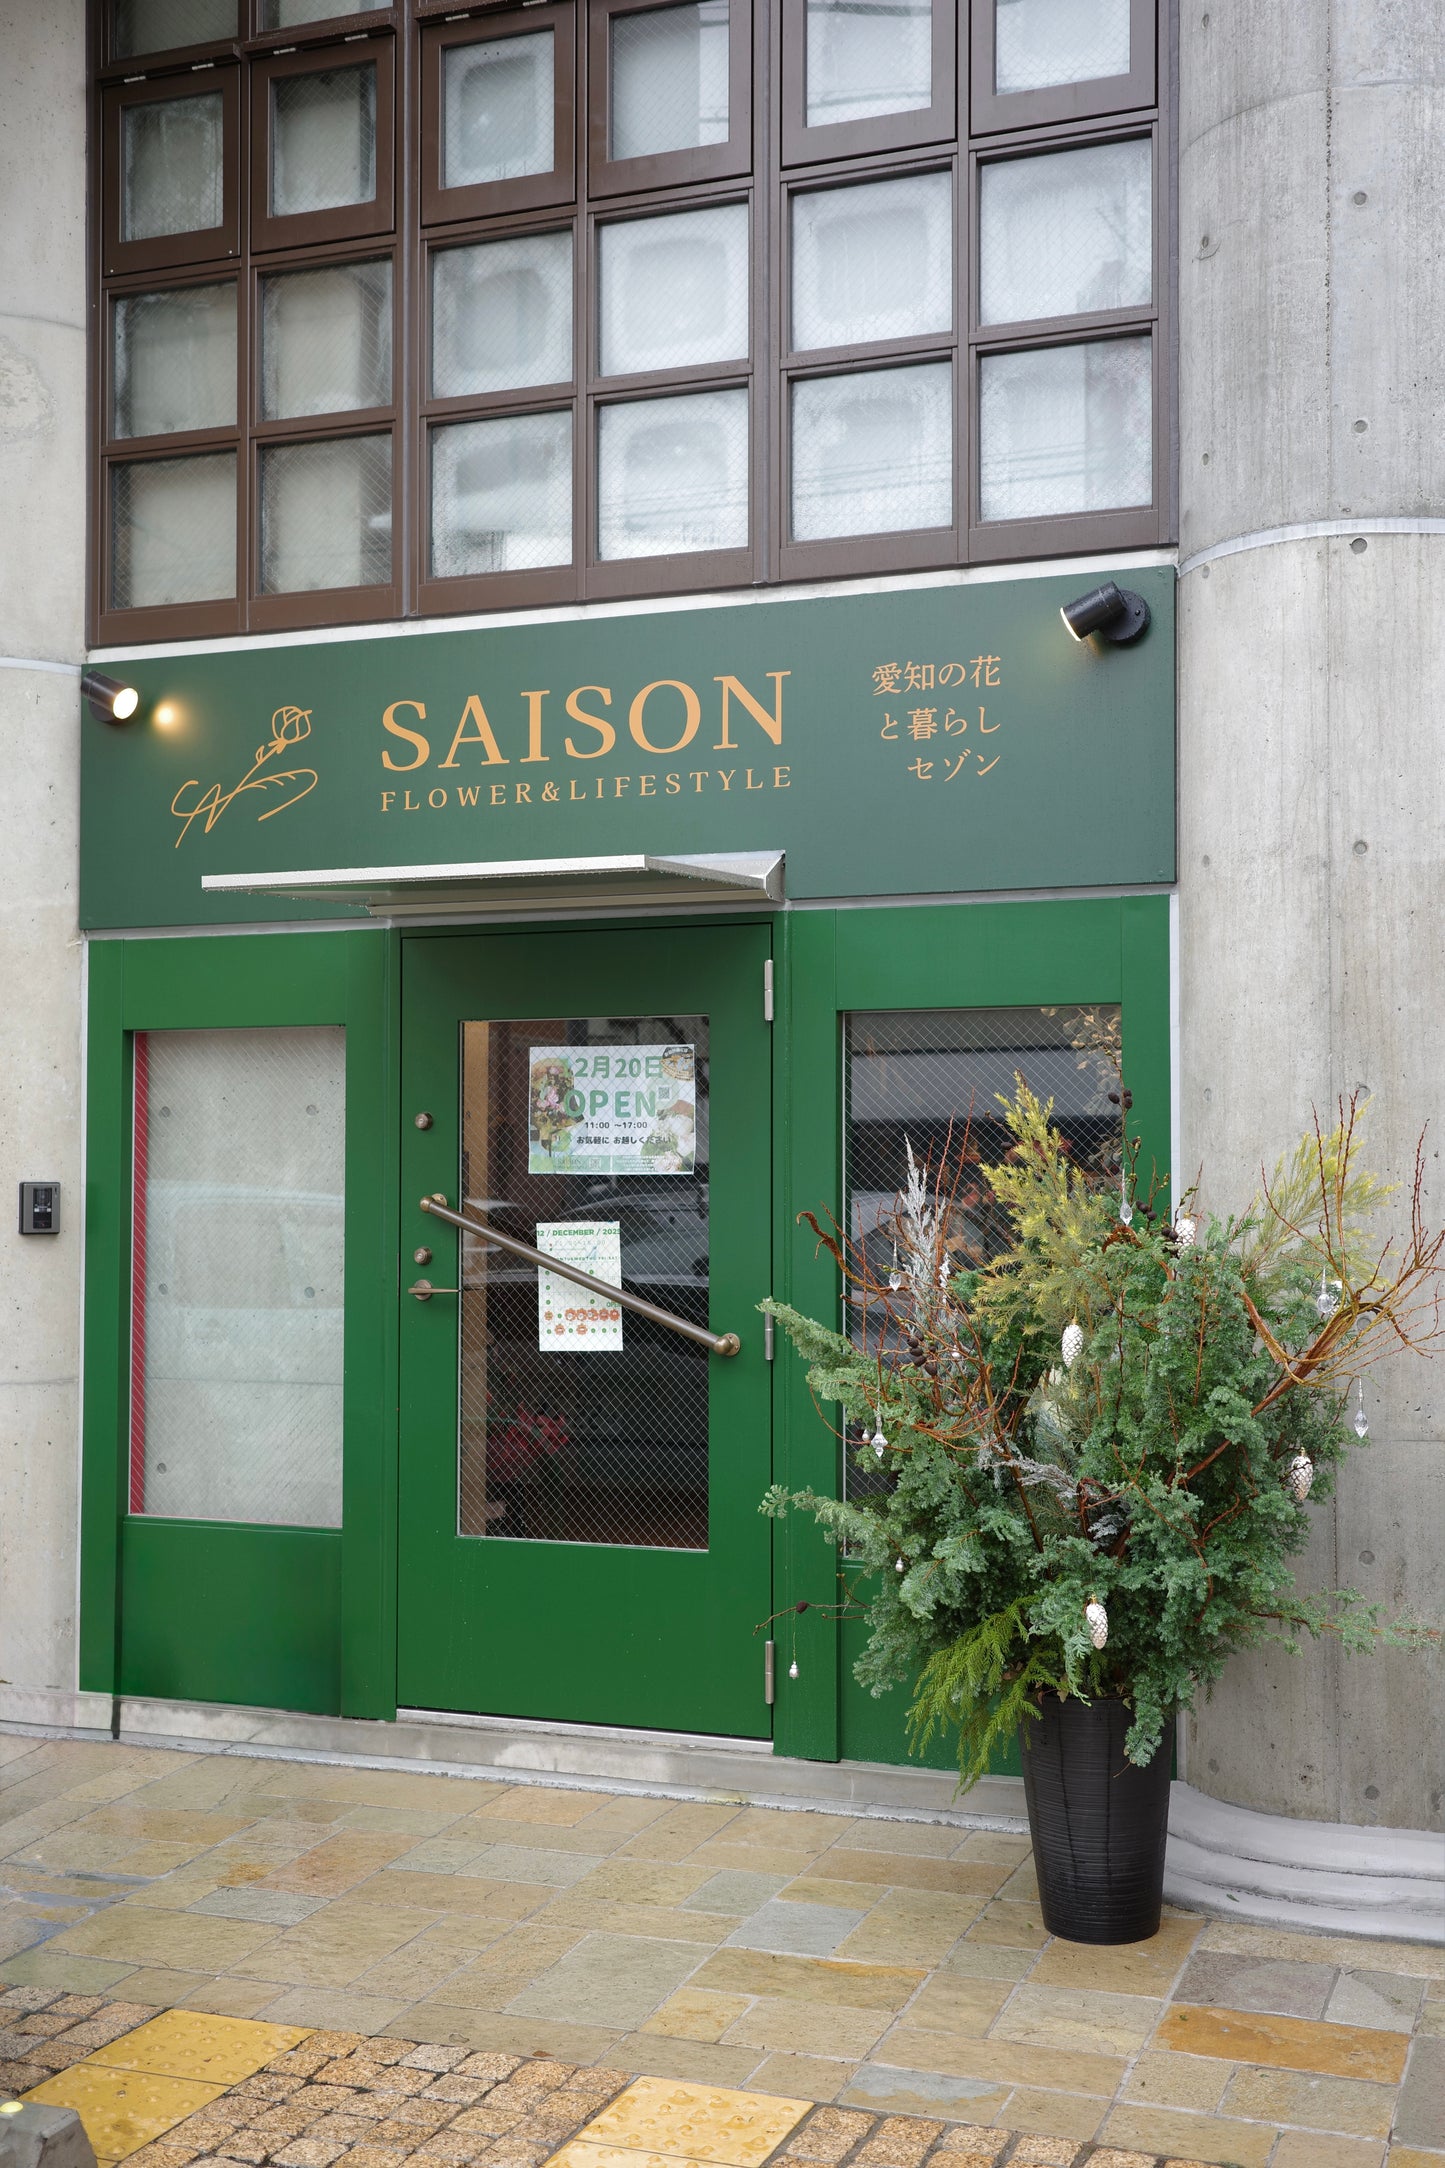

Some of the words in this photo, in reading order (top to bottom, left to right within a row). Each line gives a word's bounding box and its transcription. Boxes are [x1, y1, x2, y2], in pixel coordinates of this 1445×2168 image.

[871, 654, 1002, 697] 愛知の花
[379, 670, 792, 774] SAISON
[880, 705, 1002, 742] と暮らし
[906, 751, 1002, 783] セゾン
[379, 764, 793, 813] FLOWER&LIFESTYLE
[563, 1089, 657, 1118] OPEN
[576, 1136, 610, 1145] お気軽に
[613, 1135, 671, 1145] お越しください
[584, 1121, 610, 1129] 11:00
[552, 1229, 595, 1237] DECEMBER
